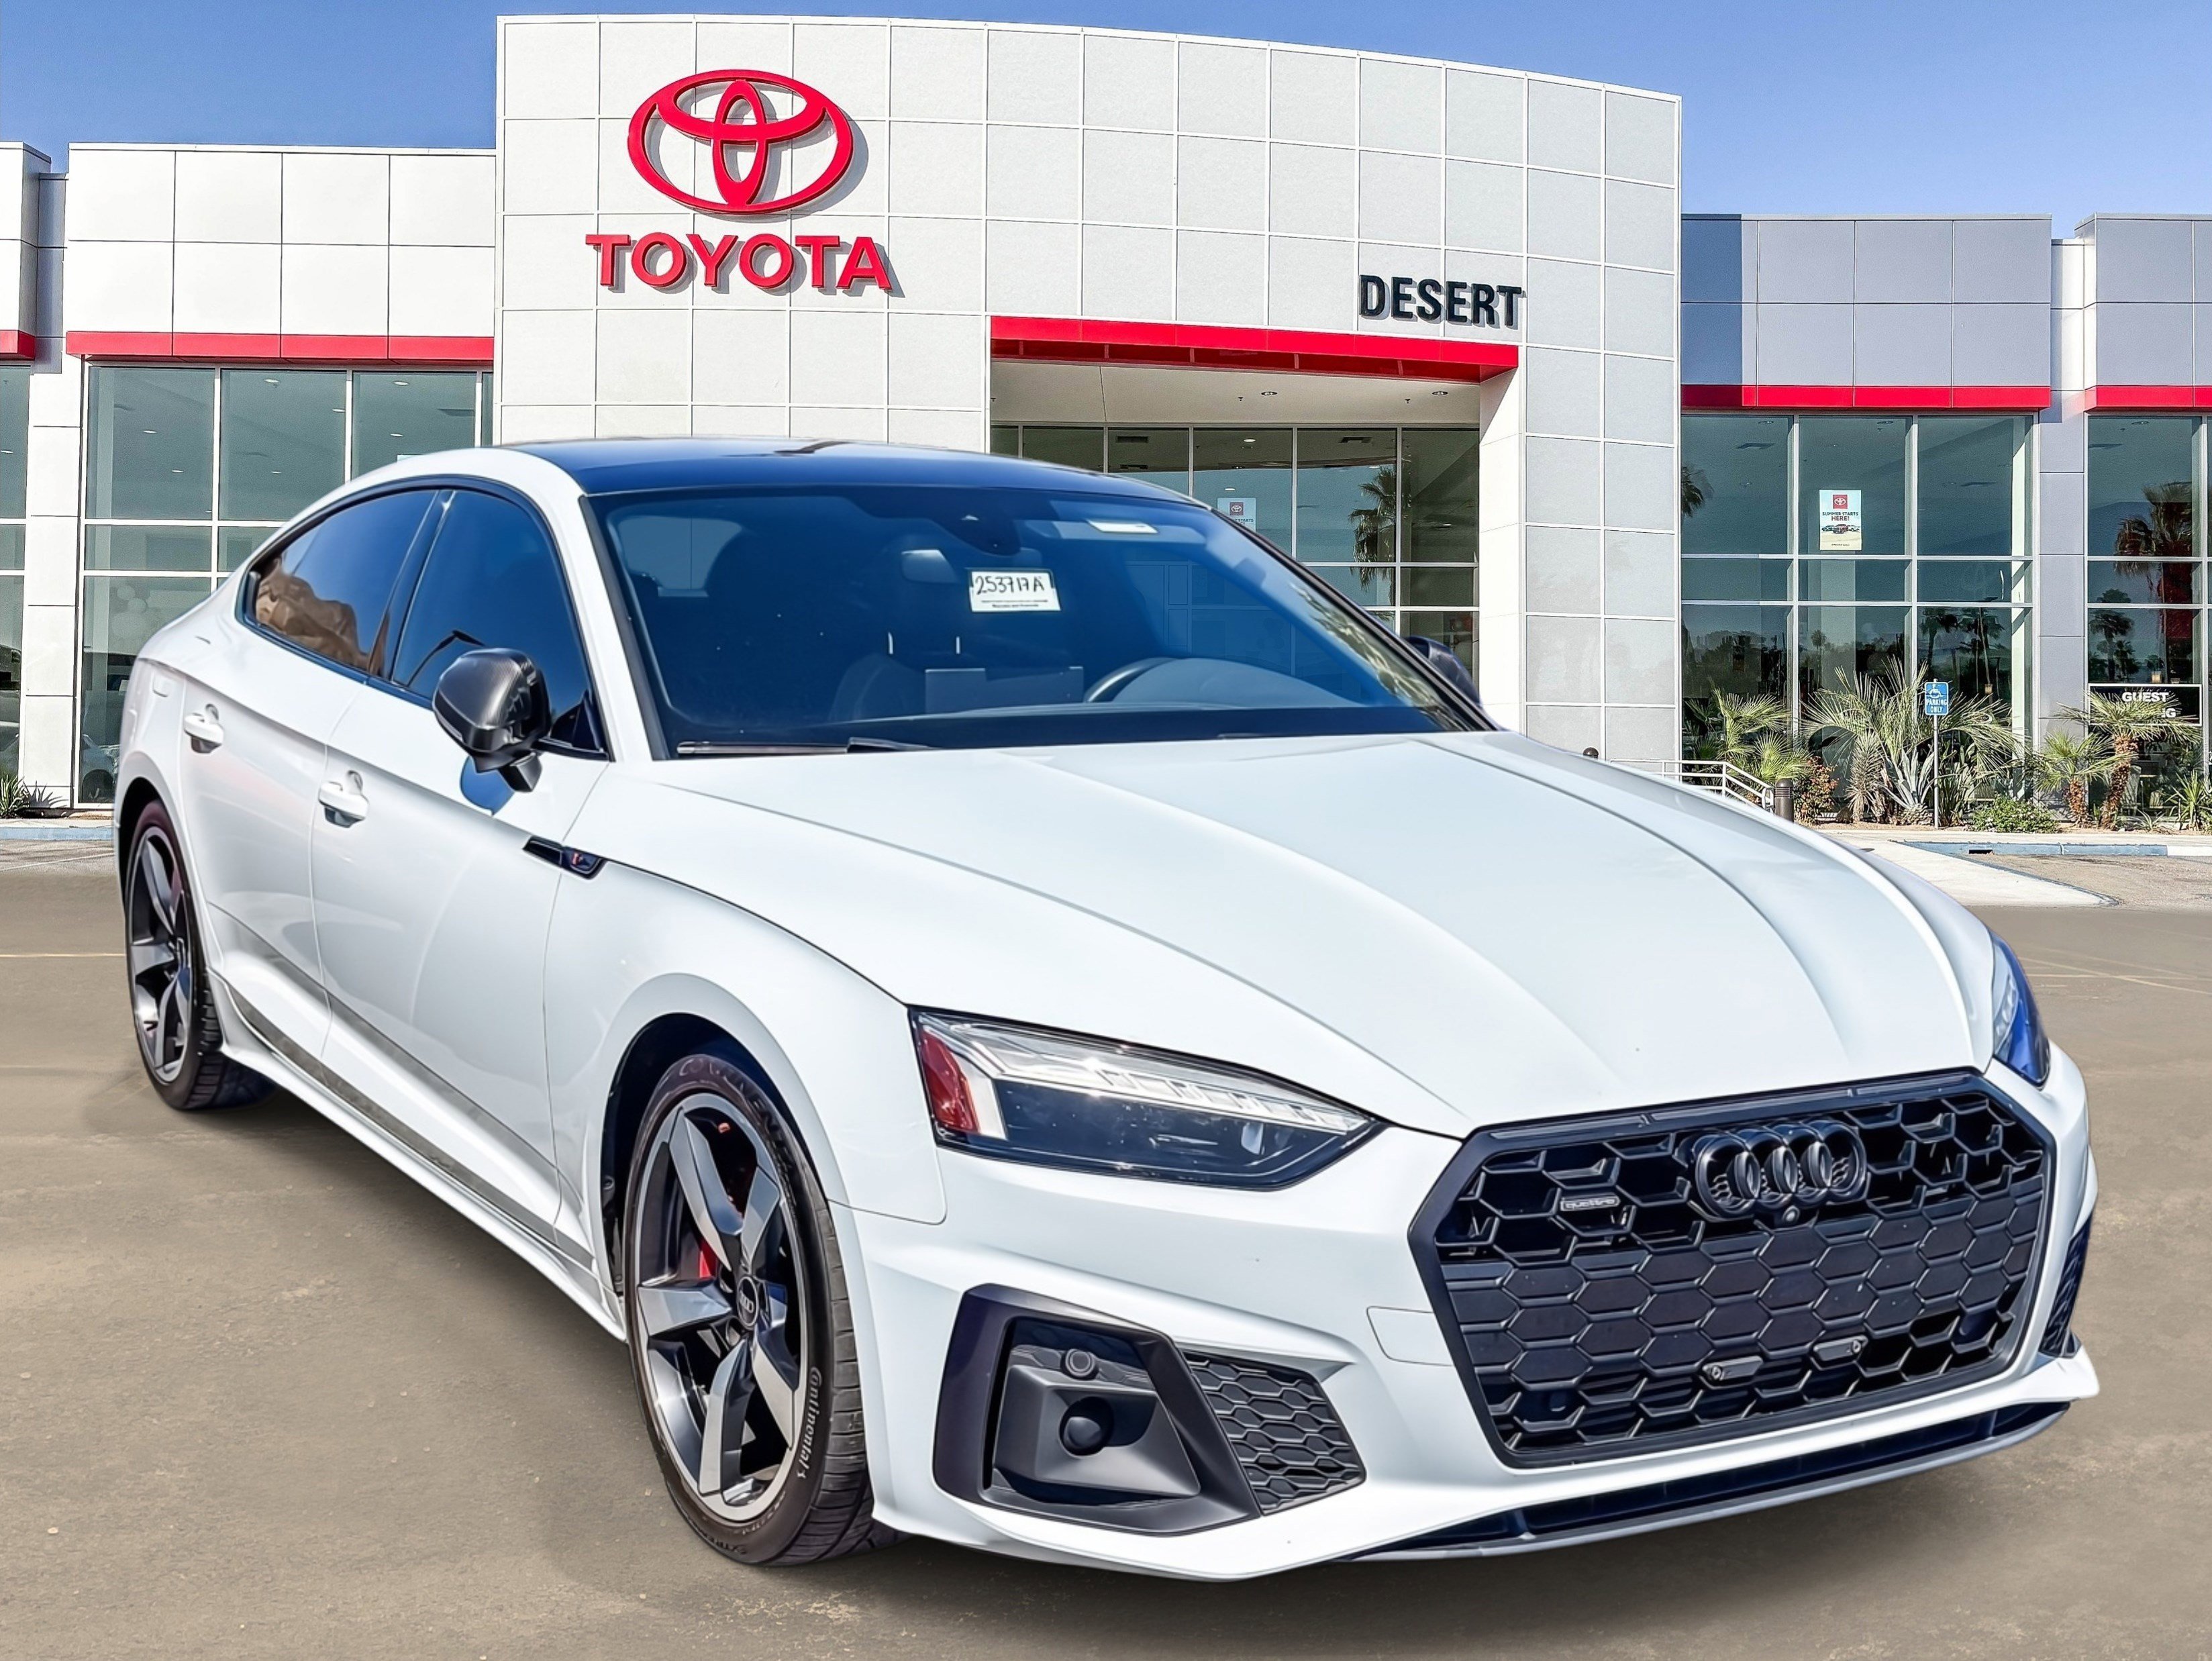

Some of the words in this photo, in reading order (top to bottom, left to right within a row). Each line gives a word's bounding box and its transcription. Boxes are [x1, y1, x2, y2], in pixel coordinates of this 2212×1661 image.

[586, 232, 892, 290] TOYOTA
[1359, 274, 1522, 327] DESERT
[1930, 705, 1944, 713] ONLY
[2121, 691, 2169, 703] GUEST
[799, 1366, 823, 1470] Continental
